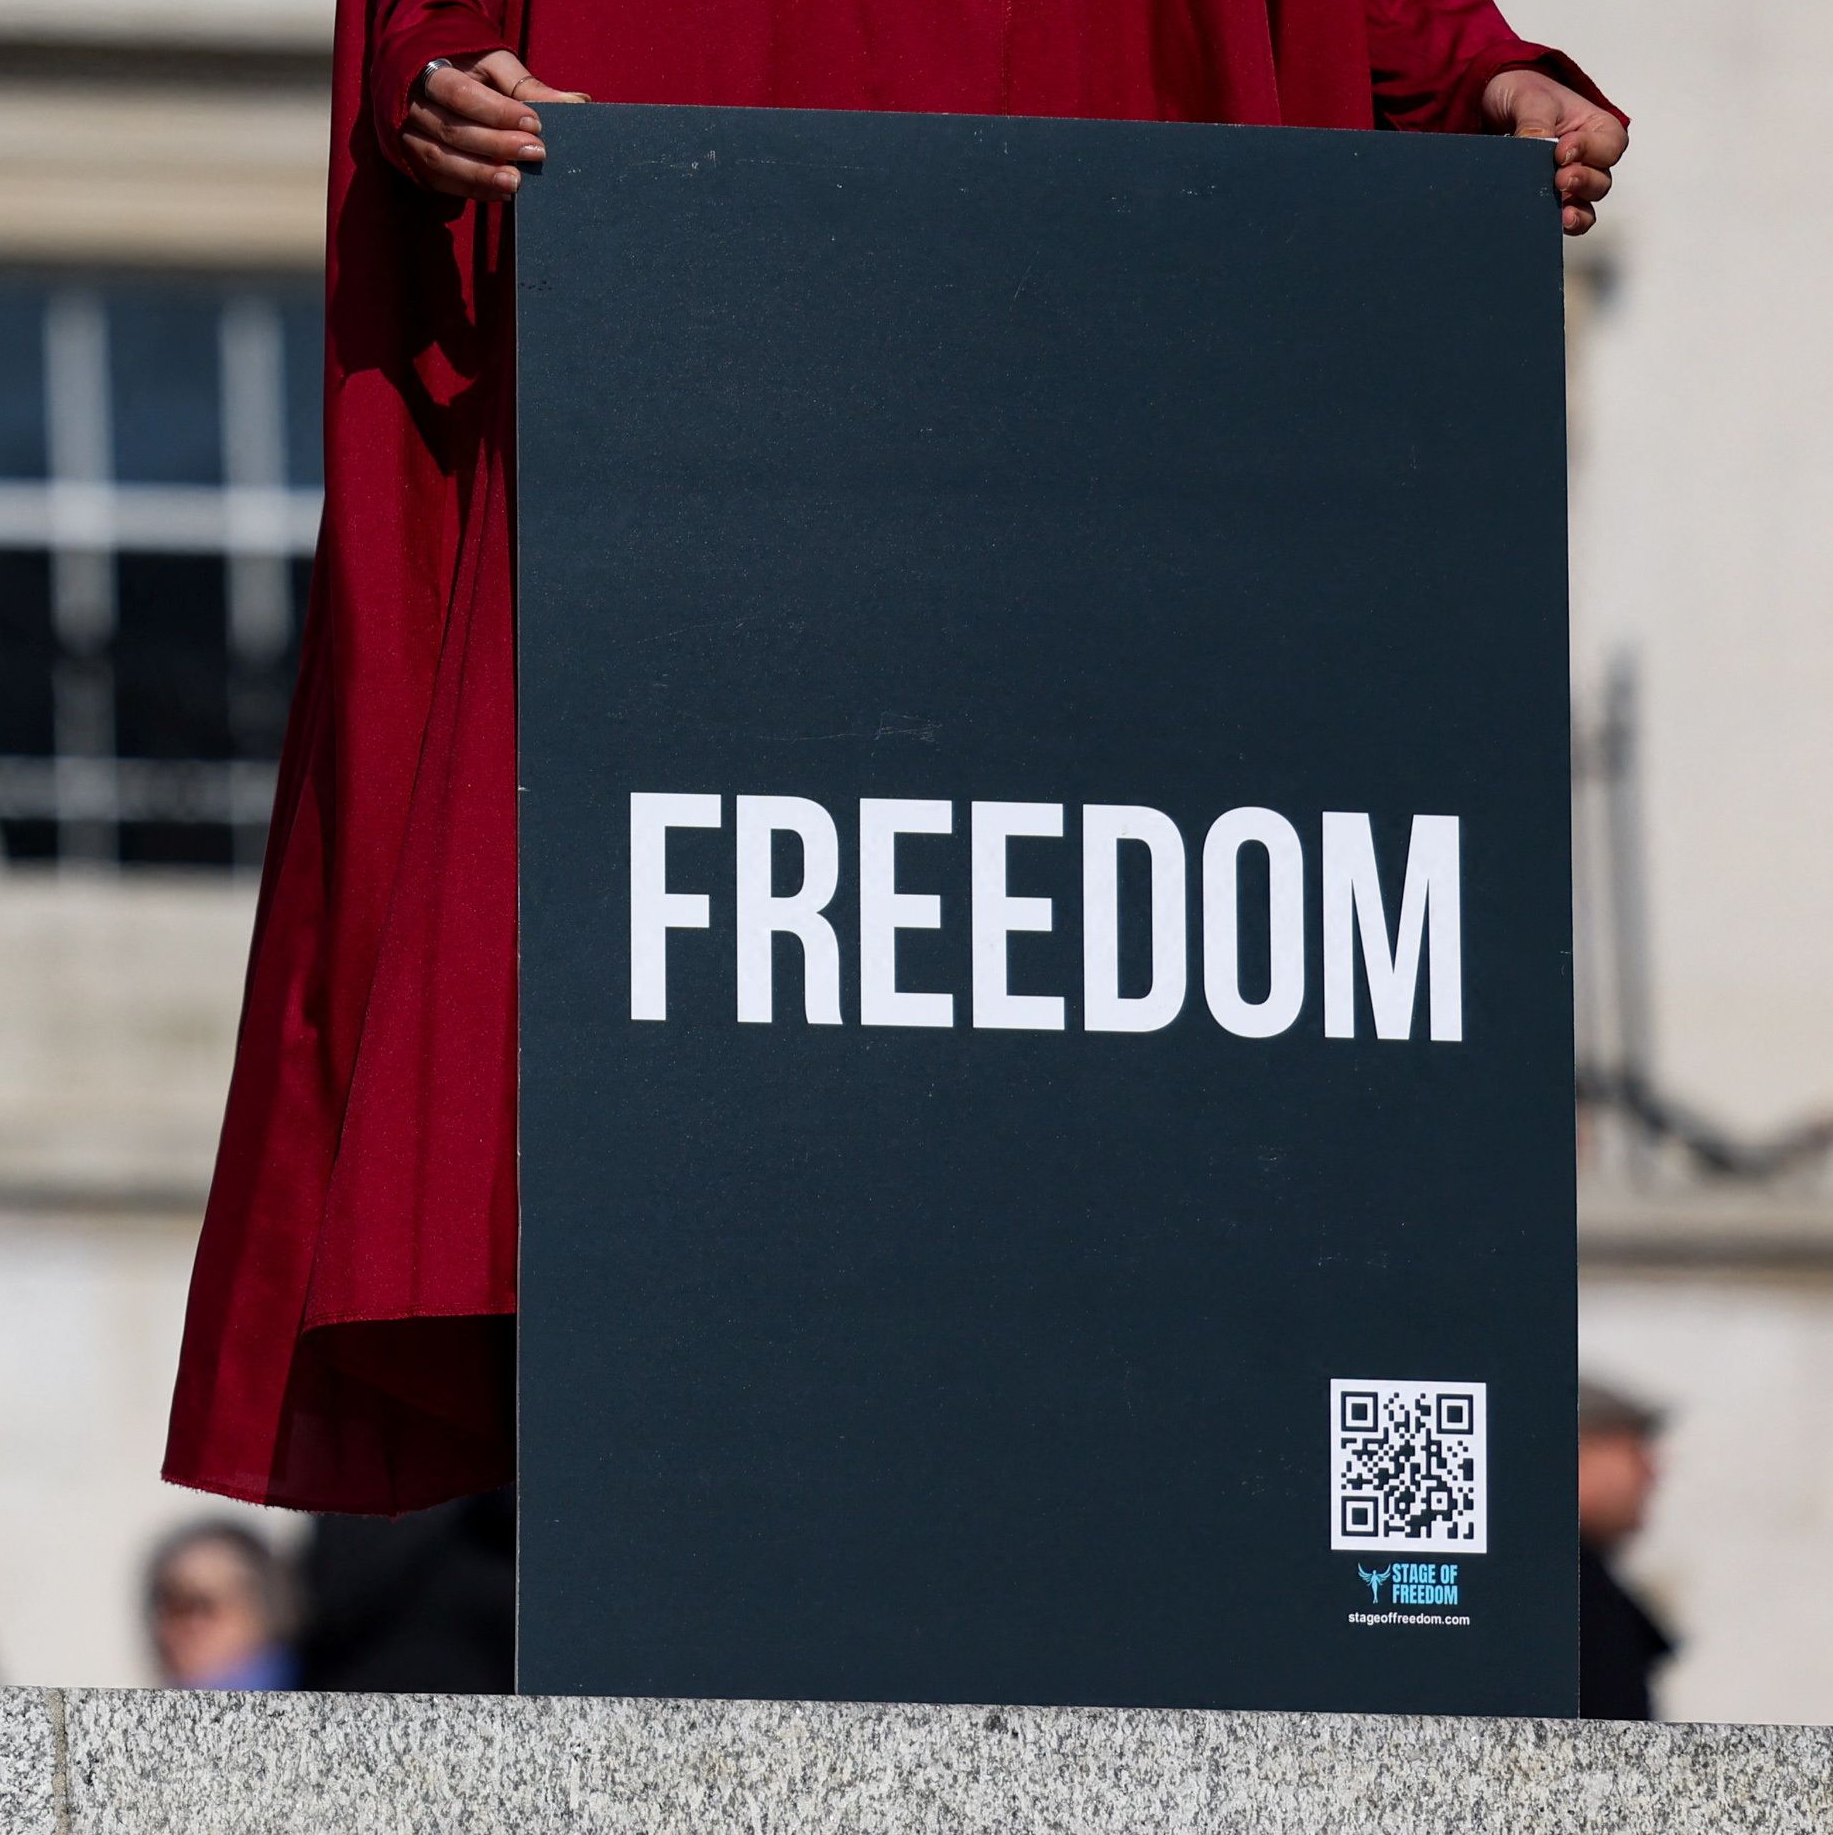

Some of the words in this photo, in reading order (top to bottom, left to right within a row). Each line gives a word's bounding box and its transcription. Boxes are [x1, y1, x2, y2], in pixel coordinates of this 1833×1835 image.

[630, 792, 1463, 1042] FREEDOM
[1392, 1563, 1436, 1583] STAGE
[1440, 1564, 1458, 1584] OF
[1392, 1584, 1458, 1605] FREEDOM
[1348, 1611, 1471, 1626] stageoffreedom.com
